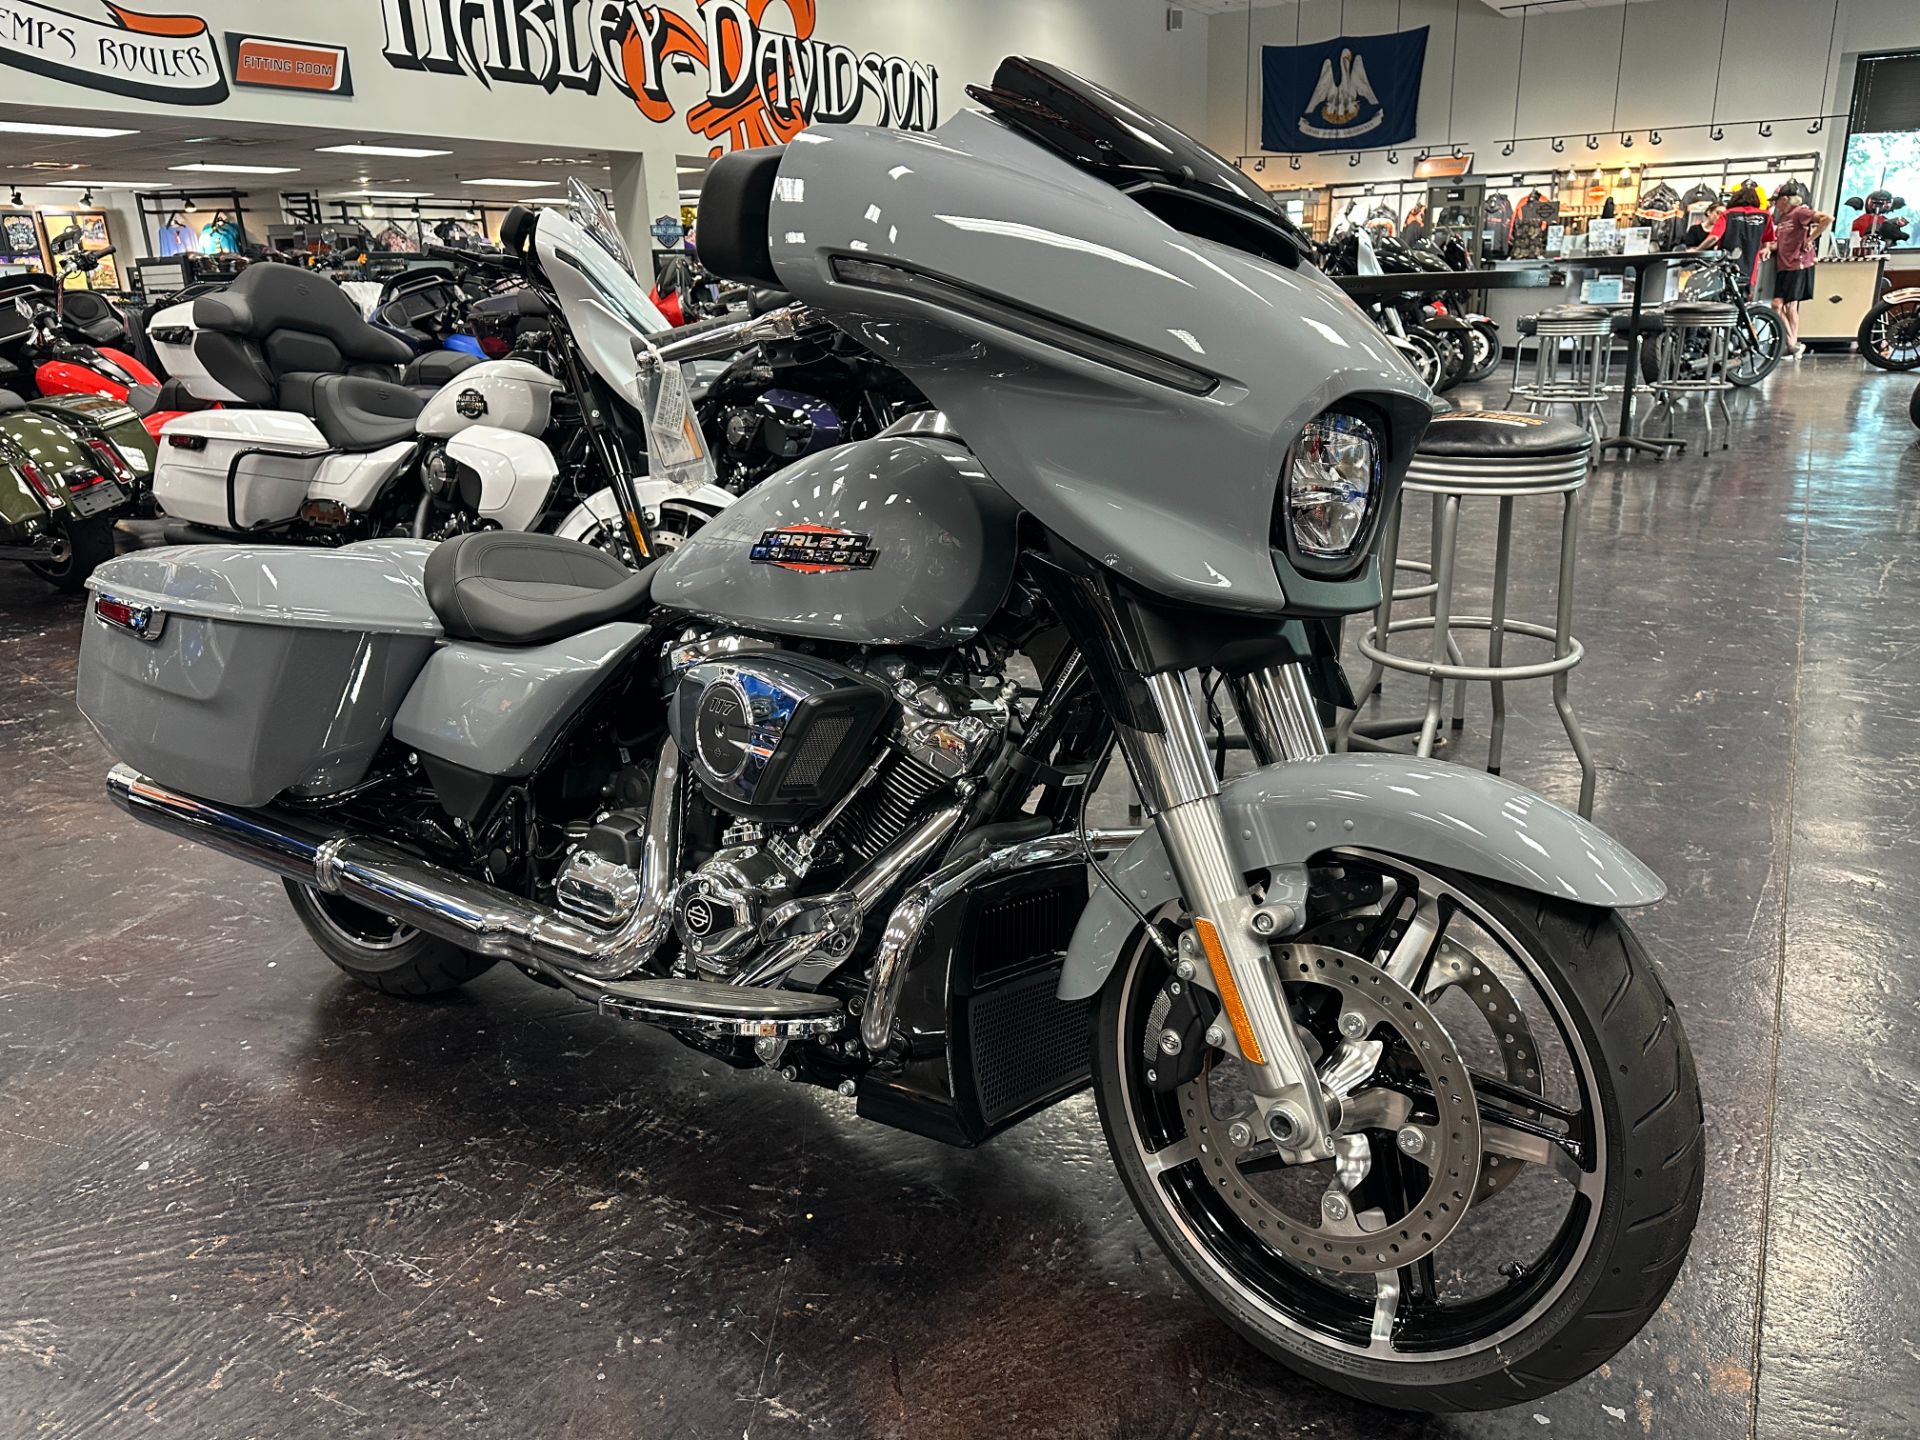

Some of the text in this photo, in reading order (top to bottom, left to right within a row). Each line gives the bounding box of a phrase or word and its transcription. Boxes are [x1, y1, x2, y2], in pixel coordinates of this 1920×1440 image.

[98, 38, 209, 77] ROULER
[243, 55, 333, 77] FITTING ROOM
[762, 533, 863, 550] HARLEY-
[751, 547, 873, 566] DAVIDSON
[709, 697, 738, 716] 117
